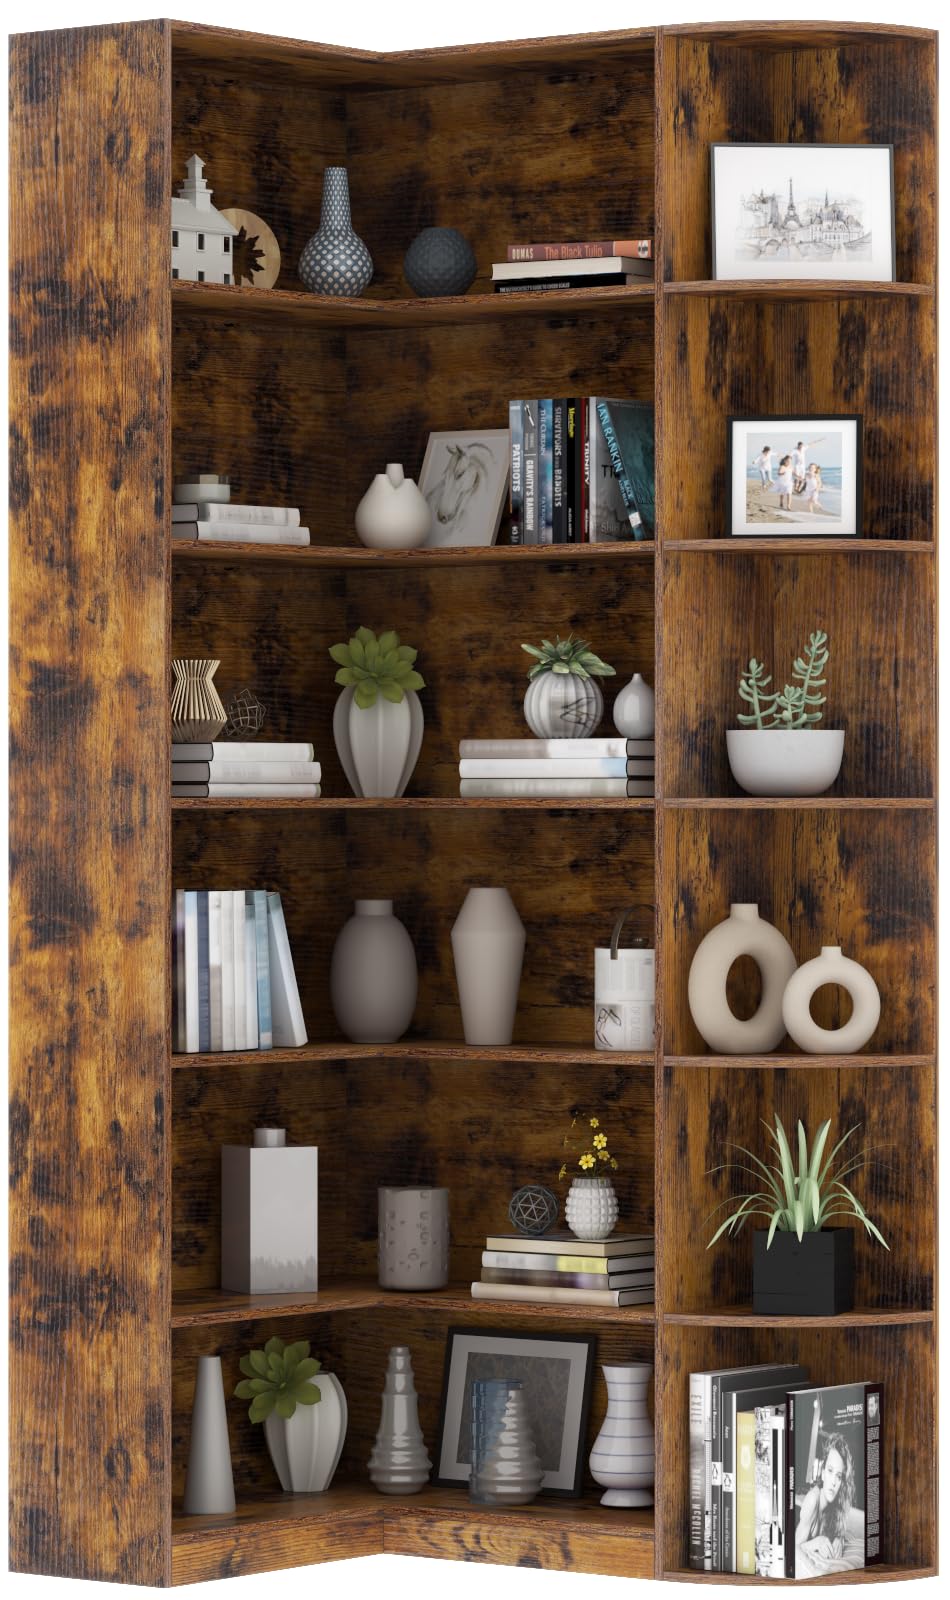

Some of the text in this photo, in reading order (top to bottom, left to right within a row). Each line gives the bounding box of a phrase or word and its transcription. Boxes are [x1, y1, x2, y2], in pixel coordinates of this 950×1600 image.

[512, 247, 534, 260] DUMAS
[544, 245, 603, 260] The Black Tulip
[554, 407, 563, 456] SURVIVORS
[596, 402, 611, 426] IAN
[512, 443, 521, 492] PATRIOTS
[603, 427, 624, 473] RANKIN
[525, 460, 534, 496] GRAVITY'S
[554, 468, 562, 508] BANDITS
[525, 497, 534, 531] RAINBOW
[690, 1394, 703, 1424] EXILE
